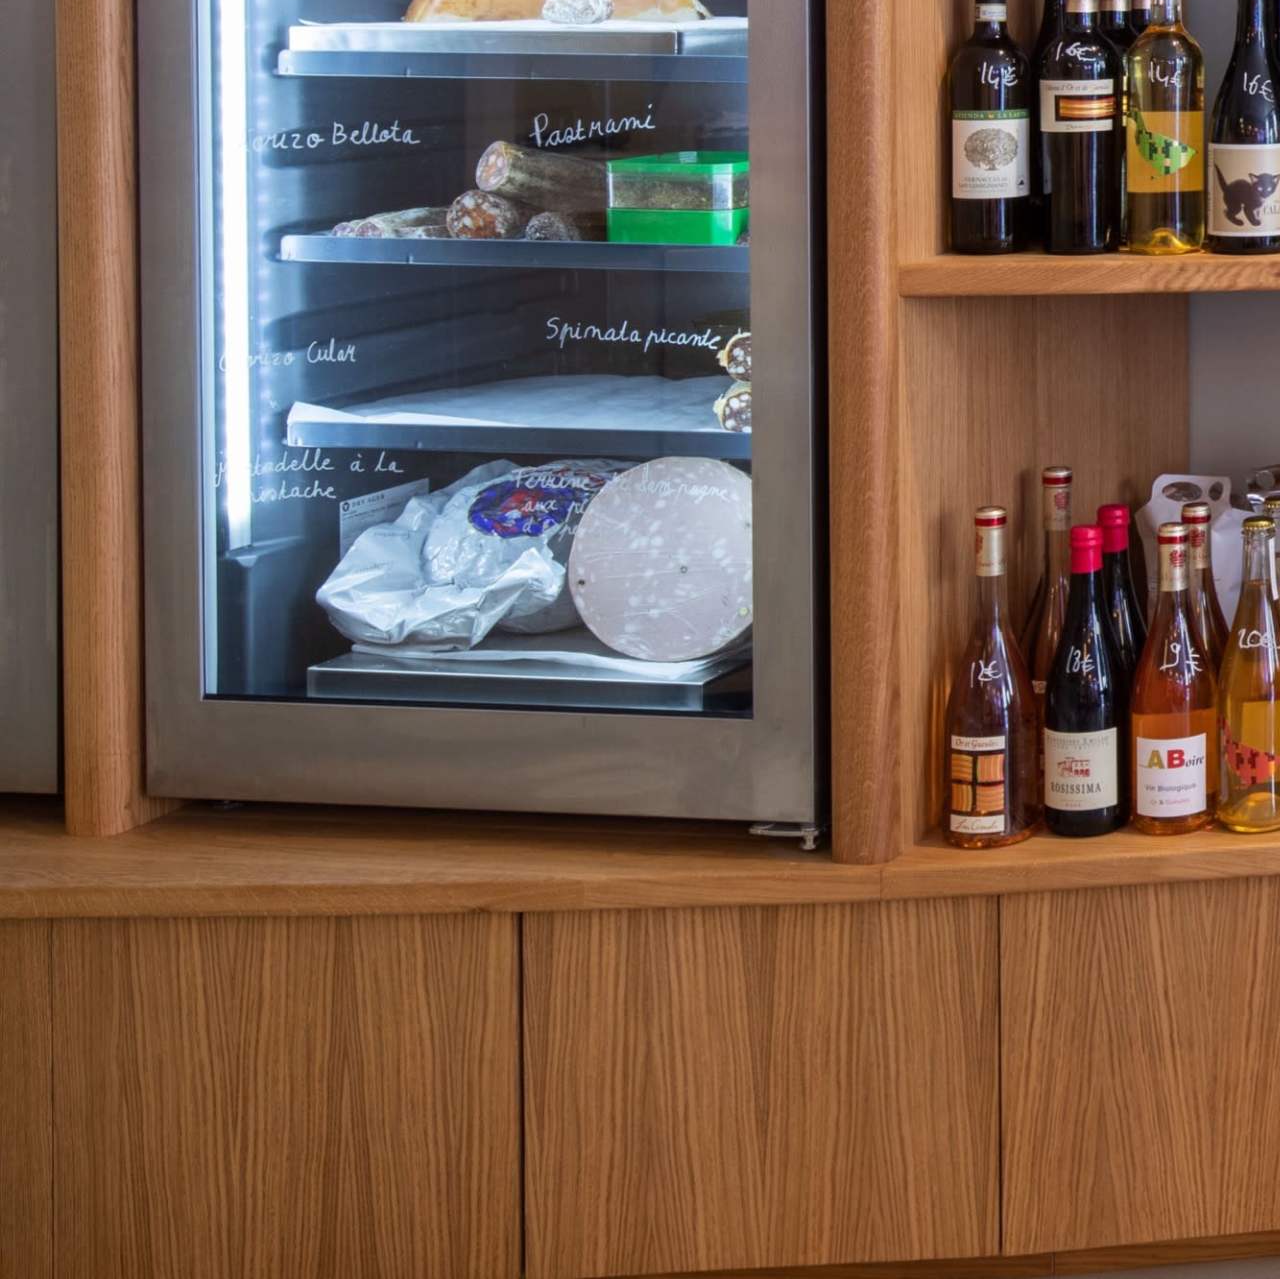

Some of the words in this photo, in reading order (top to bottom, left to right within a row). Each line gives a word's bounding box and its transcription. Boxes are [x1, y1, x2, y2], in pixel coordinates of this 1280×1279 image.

[980, 61, 1019, 90] 14€
[1149, 61, 1183, 88] 14€
[1243, 71, 1275, 102] 16€
[332, 120, 421, 146] Bellota
[529, 104, 656, 149] Pastrami
[645, 322, 721, 351] picante
[306, 337, 357, 363] Cular
[350, 453, 366, 473] à
[374, 451, 405, 473] la
[1237, 628, 1280, 651] 20€
[1050, 781, 1102, 794] ROSISSIMA
